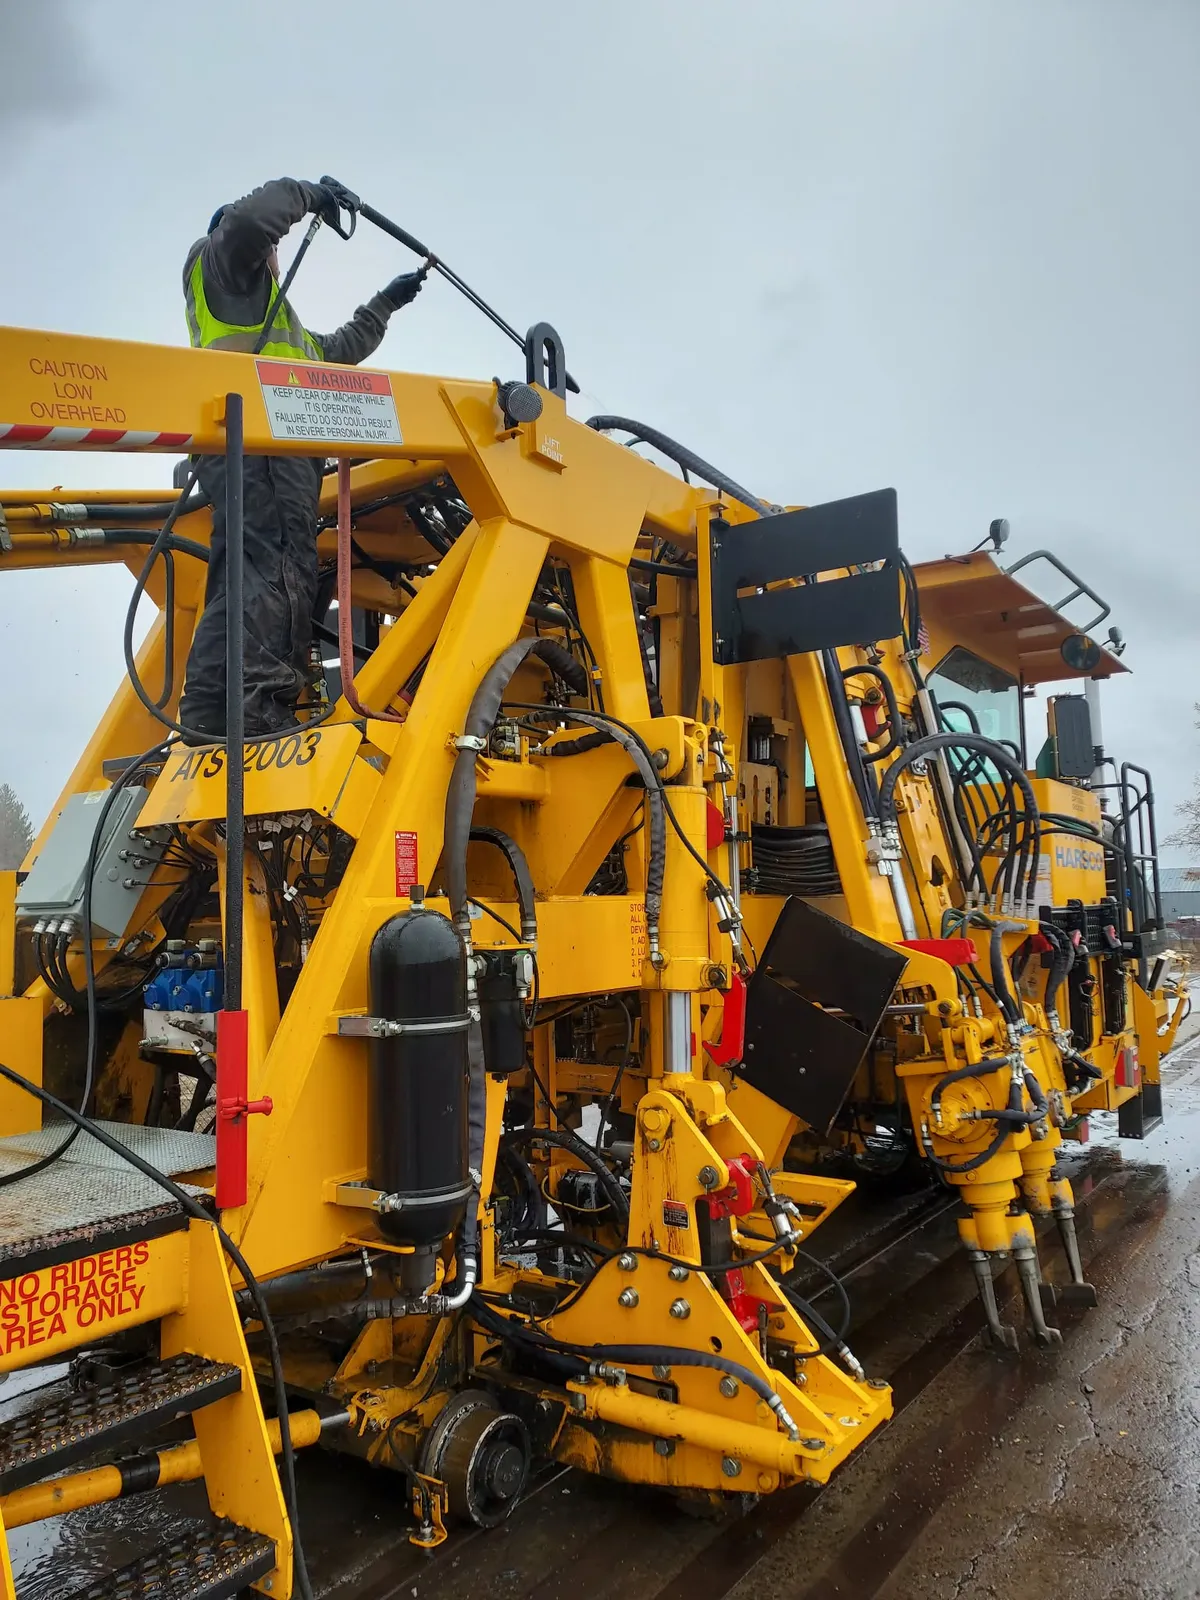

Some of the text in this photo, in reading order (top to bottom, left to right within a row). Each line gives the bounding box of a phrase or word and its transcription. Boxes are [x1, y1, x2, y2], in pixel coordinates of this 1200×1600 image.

[29, 358, 108, 381] CAUTION
[53, 382, 92, 400] LOW
[307, 371, 373, 391] WARNING
[272, 387, 386, 406] KEEP CLEAR OF MACHINE WHILE
[30, 401, 126, 423] OVERHEAD
[304, 402, 364, 415] IT IS OPERATING.
[275, 412, 392, 429] FAILURE TO DO SO COULD RESULT
[286, 425, 295, 435] IN
[296, 426, 326, 437] SEVERE
[327, 427, 364, 439] PERSONAL
[544, 434, 560, 450] LIFT
[541, 444, 564, 464] POINT
[170, 731, 322, 783] ATS 2003
[1055, 845, 1103, 871] HARSCO
[0, 1241, 150, 1307] NO RIDERS
[1, 1266, 137, 1330] STORAGE
[0, 1285, 146, 1356] REA ONLY
